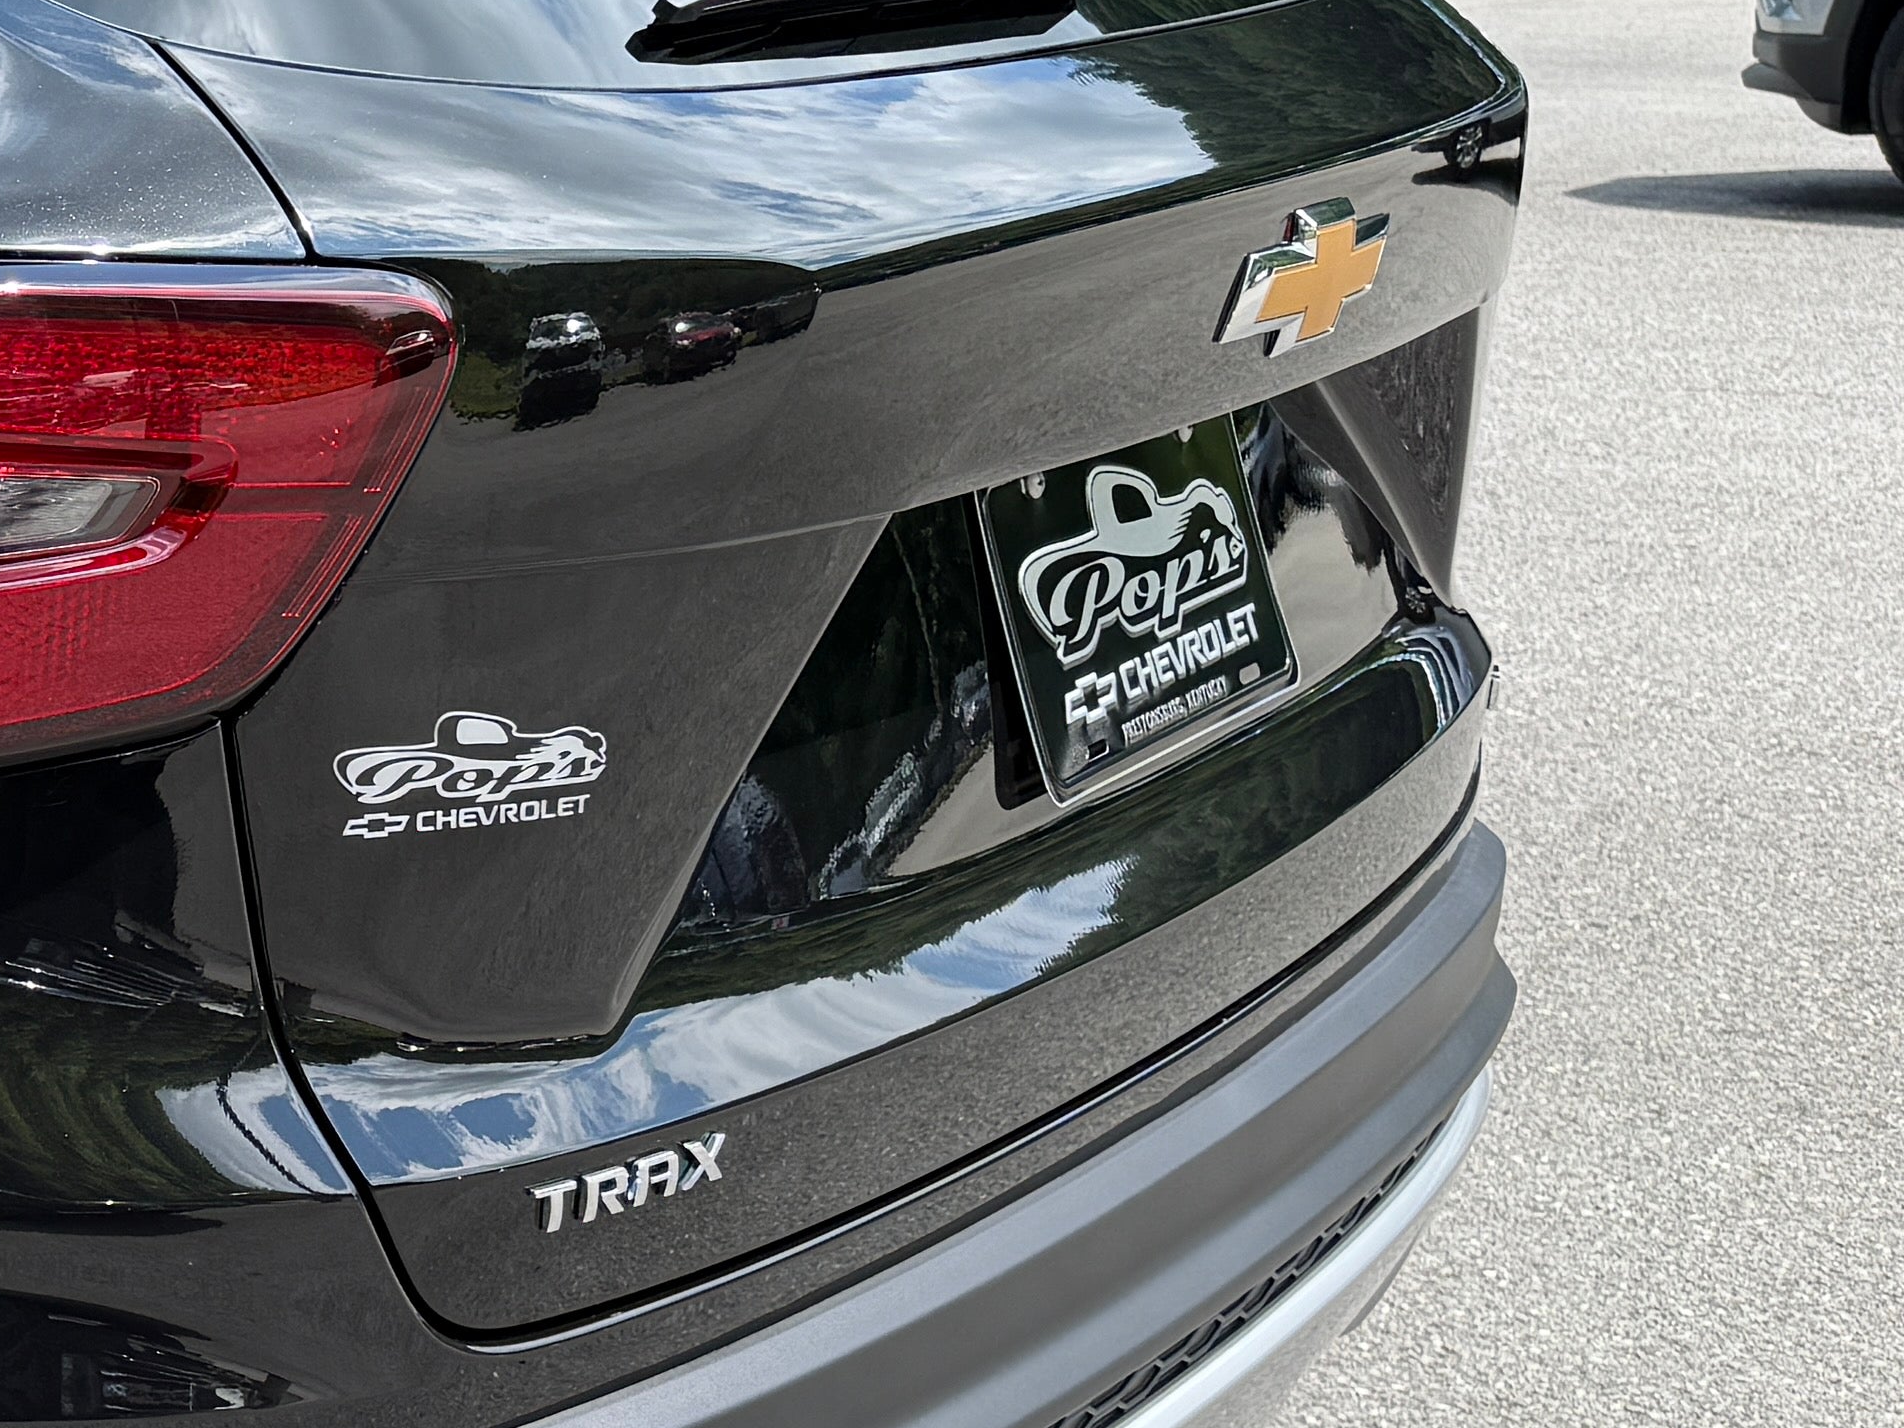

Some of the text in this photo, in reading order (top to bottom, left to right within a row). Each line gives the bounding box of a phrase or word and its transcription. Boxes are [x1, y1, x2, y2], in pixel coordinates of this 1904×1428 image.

[1049, 528, 1242, 645] Pop's
[1119, 602, 1261, 700] CHEVROLET
[1185, 674, 1228, 713] KENTUCKY
[415, 793, 591, 833] CHEVROLET
[529, 1131, 726, 1234] TRAX
